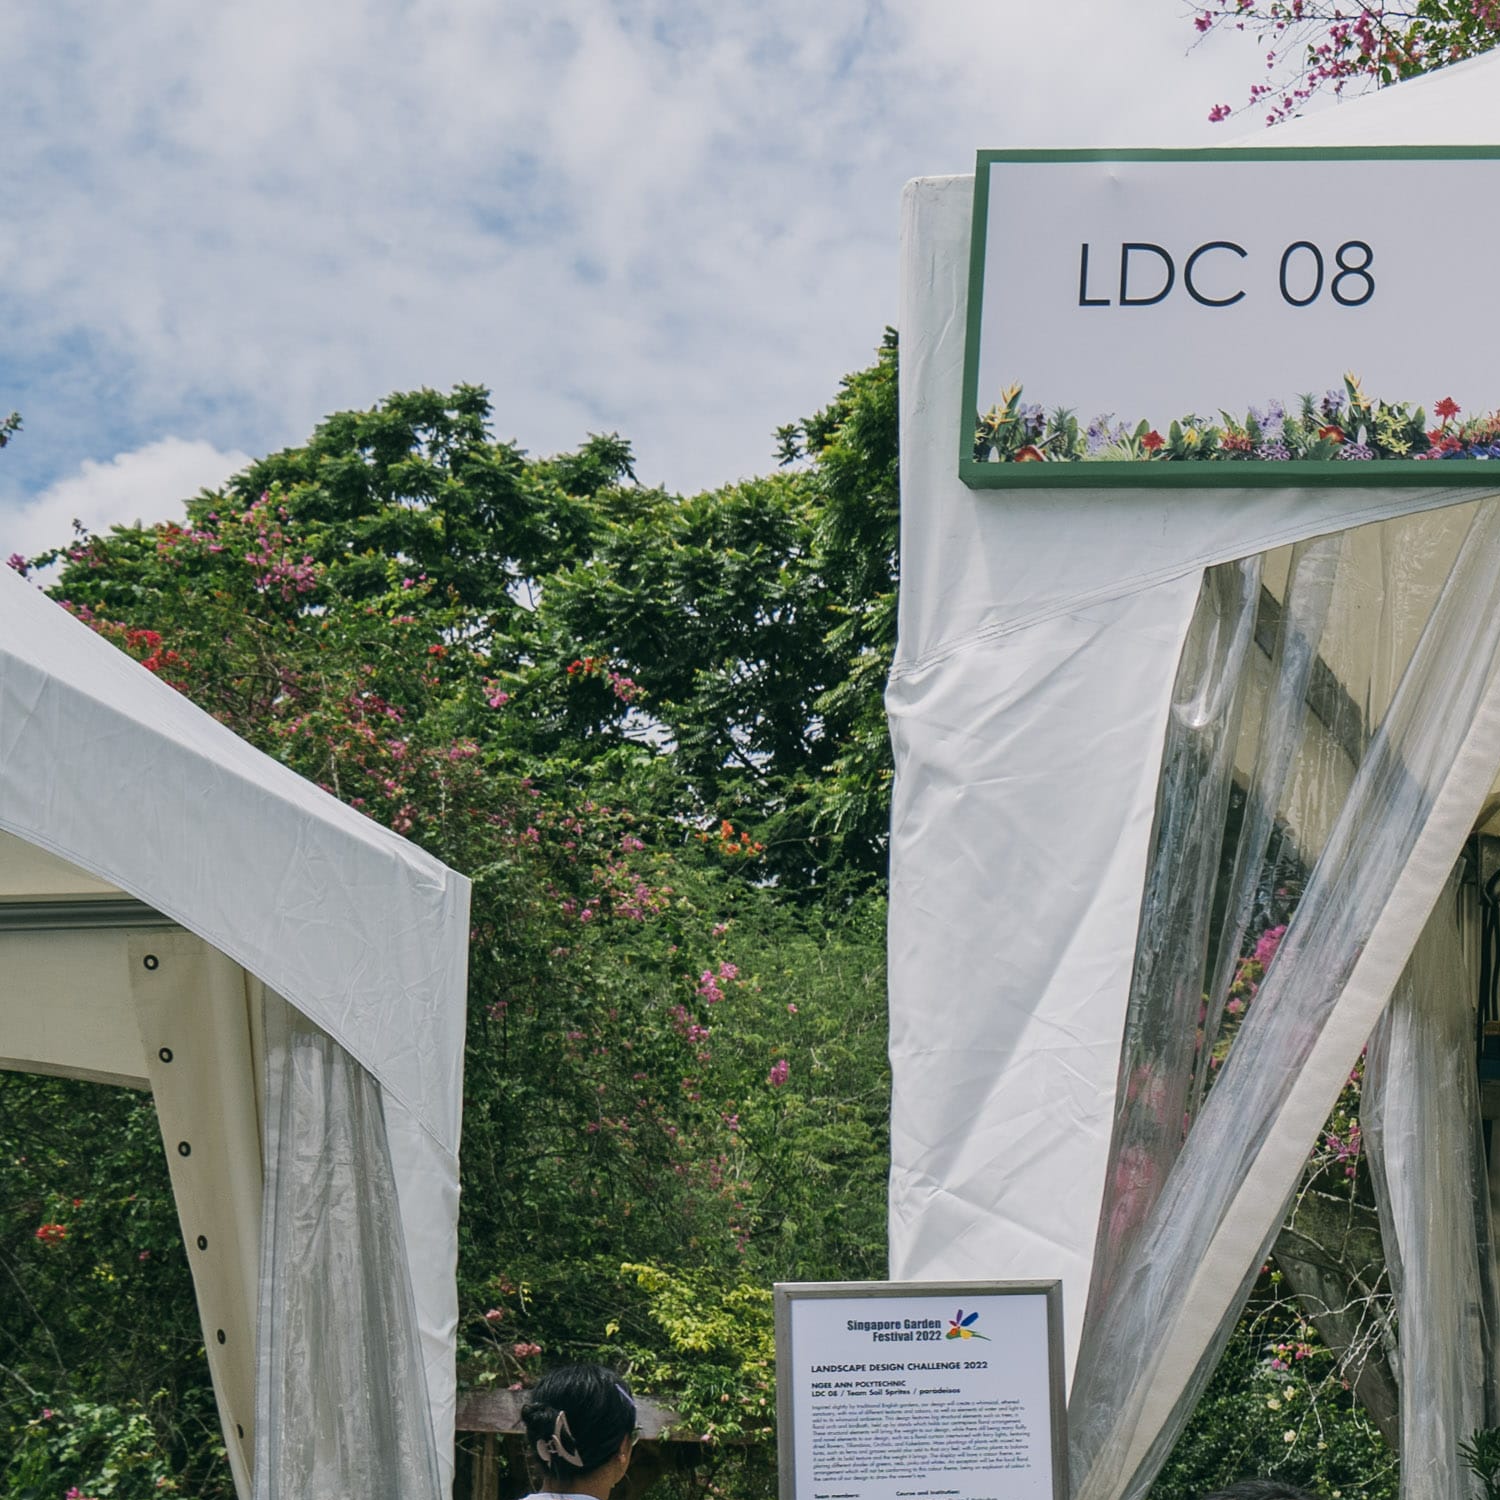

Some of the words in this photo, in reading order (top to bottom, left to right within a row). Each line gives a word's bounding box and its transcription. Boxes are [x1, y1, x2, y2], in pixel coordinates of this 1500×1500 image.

[1078, 240, 1248, 308] LDC
[1279, 240, 1376, 307] 08
[848, 1320, 900, 1332] Singapore
[904, 1318, 941, 1330] Garden
[873, 1331, 913, 1342] Festival
[916, 1330, 941, 1341] 2022
[811, 1364, 866, 1372] LANDSCAPE
[869, 1363, 904, 1371] DESIGN
[908, 1362, 960, 1370] CHALLENGE
[963, 1361, 988, 1369] 2022
[855, 1380, 906, 1388] POLYTECHNIC
[885, 1388, 910, 1397] Sprites
